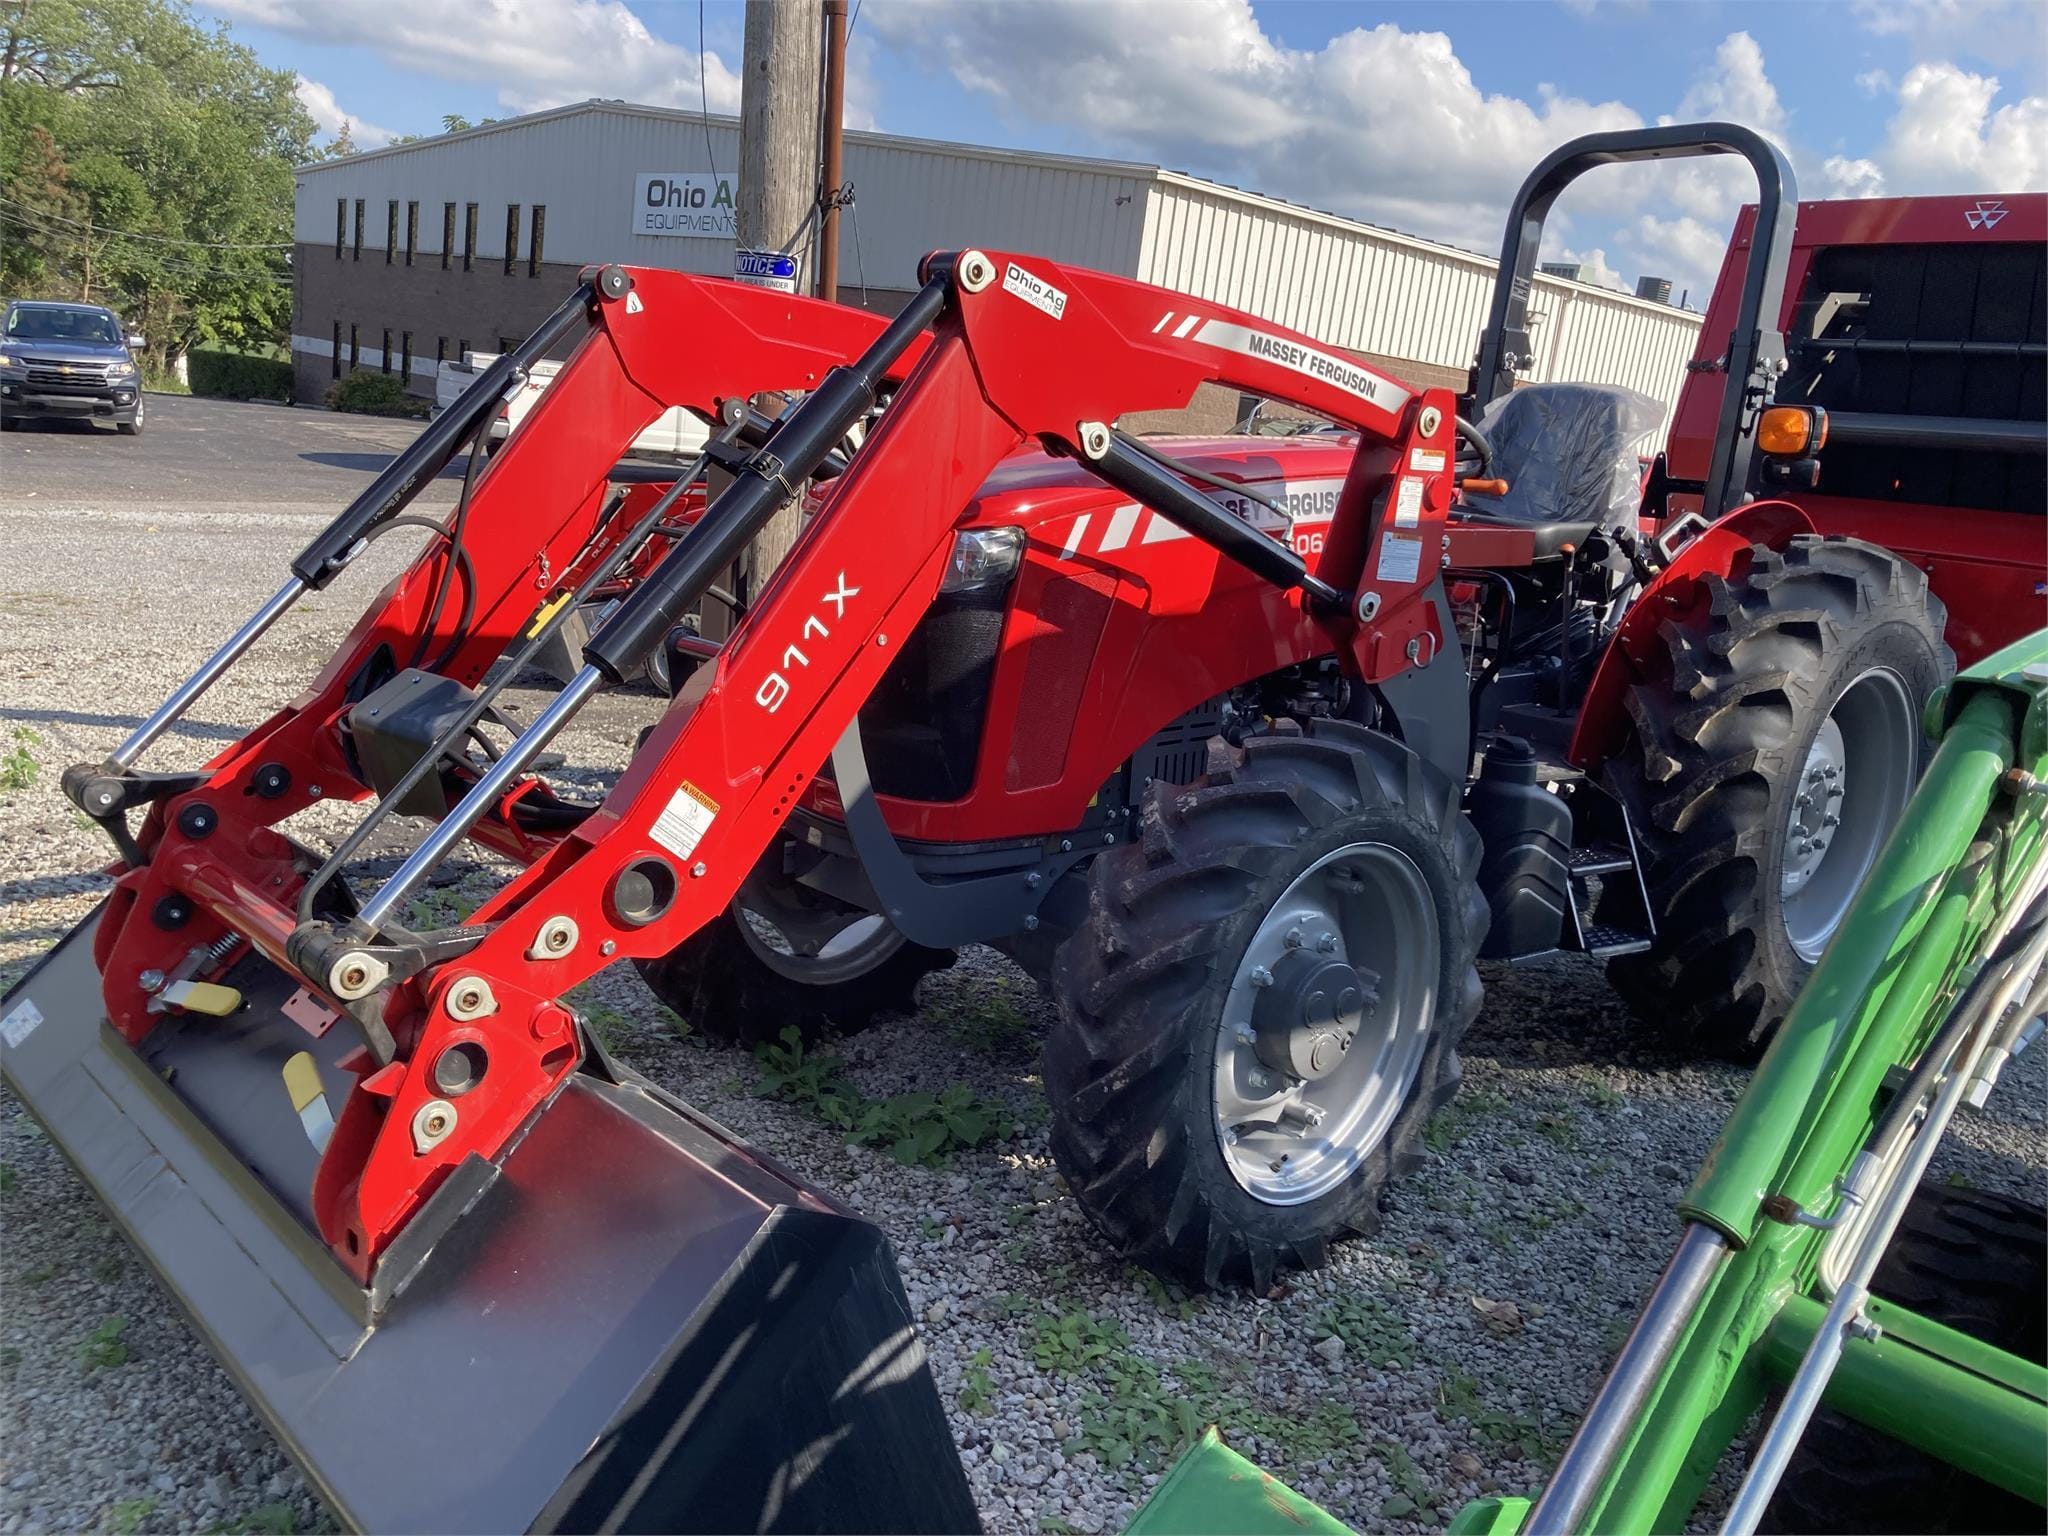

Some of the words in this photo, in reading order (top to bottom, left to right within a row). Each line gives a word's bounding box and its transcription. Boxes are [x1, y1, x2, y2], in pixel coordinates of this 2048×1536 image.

[647, 179, 706, 209] Ohio
[711, 179, 738, 209] A
[645, 213, 733, 232] EQUIPMENT
[736, 255, 775, 274] NOTICE
[767, 279, 789, 289] UNDER
[1004, 280, 1053, 311] EQUIPMENT
[1007, 266, 1042, 294] Ohio
[1043, 289, 1065, 311] Ag
[1248, 334, 1308, 367] MASSEY
[1309, 355, 1377, 399] FERGUSON
[755, 570, 861, 713] 911X
[688, 787, 719, 814] WARNING
